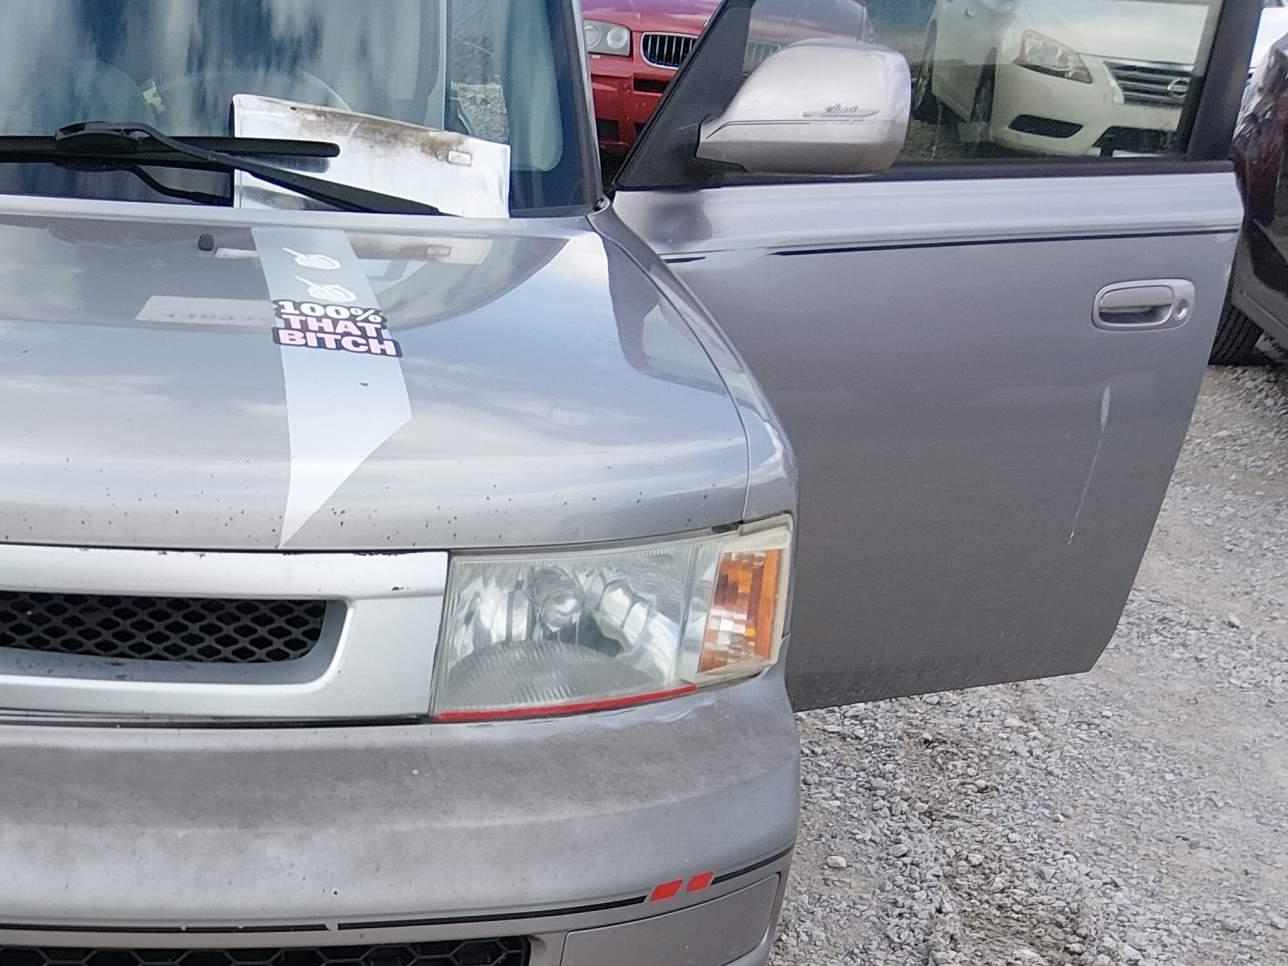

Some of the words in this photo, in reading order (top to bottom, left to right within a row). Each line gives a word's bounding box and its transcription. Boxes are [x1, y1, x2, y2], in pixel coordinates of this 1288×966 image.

[278, 301, 382, 323] 100%
[281, 315, 382, 337] THAT
[278, 329, 397, 355] BITCH
